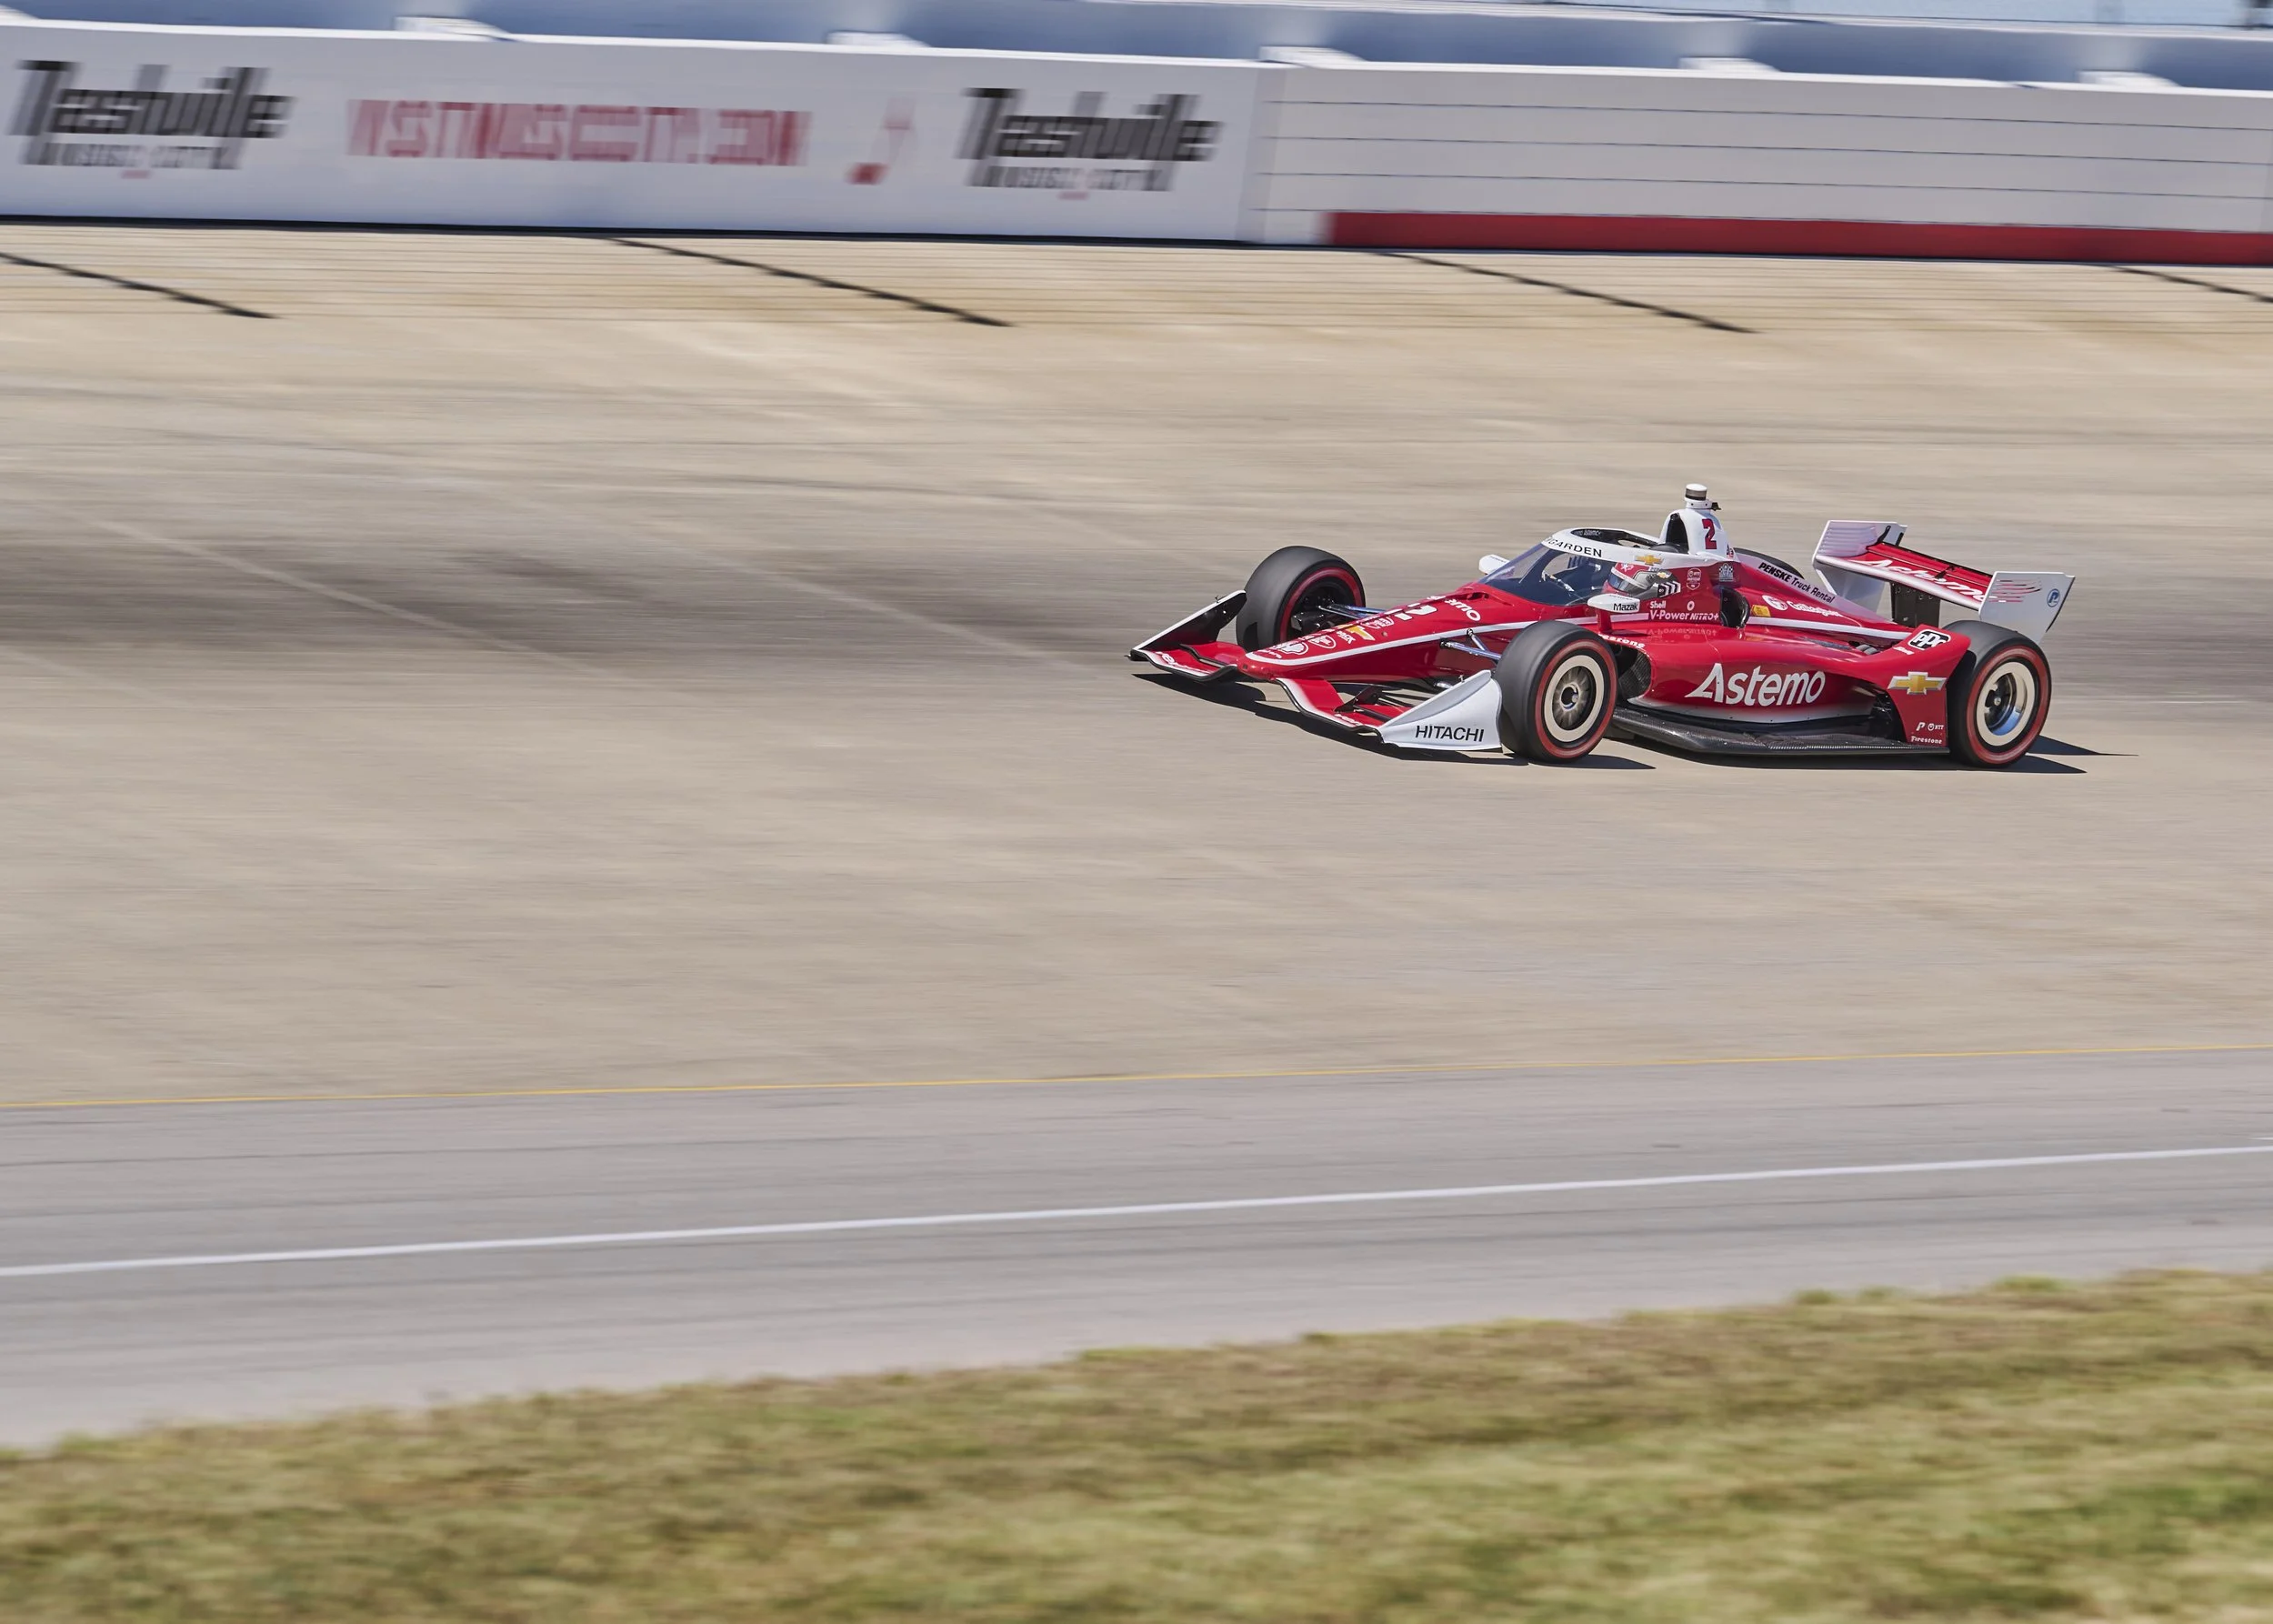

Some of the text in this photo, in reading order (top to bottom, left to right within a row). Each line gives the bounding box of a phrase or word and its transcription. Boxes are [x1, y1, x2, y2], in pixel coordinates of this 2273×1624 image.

[1701, 518, 1717, 550] 2
[1546, 536, 1603, 558] GARDEN
[1757, 562, 1836, 604] PENSKE Truck Rental
[1613, 602, 1638, 611] Mazak
[1650, 600, 1667, 609] Shell
[1650, 610, 1689, 620] V-Power
[1684, 662, 1826, 707] Astemo
[1415, 725, 1485, 742] HITACHI
[1910, 736, 1942, 745] Firestone
